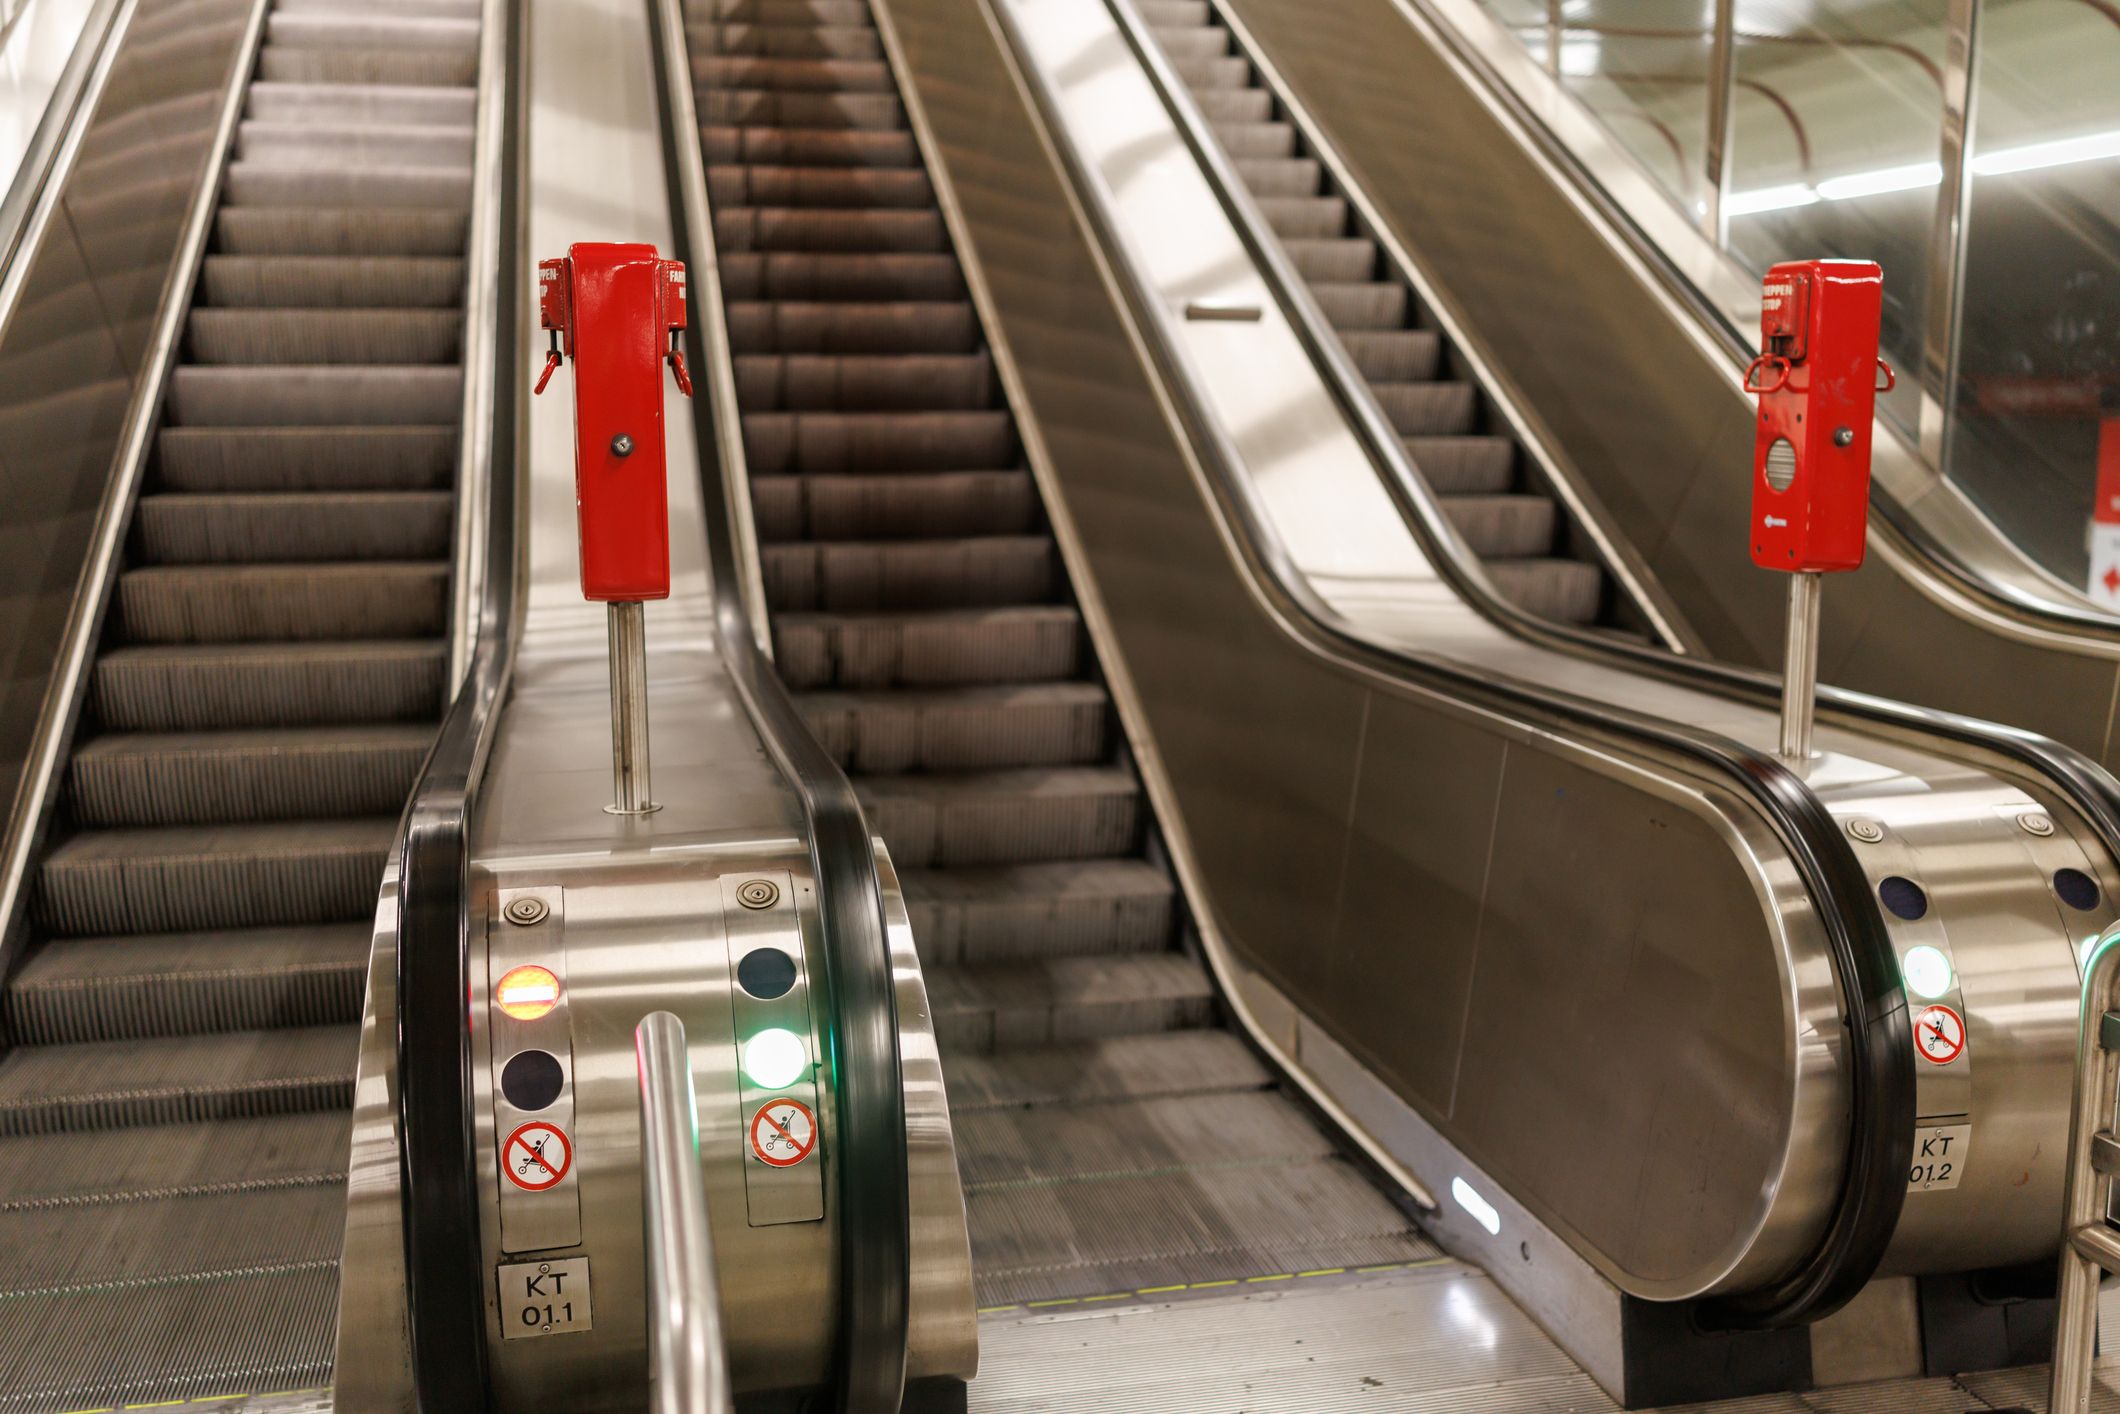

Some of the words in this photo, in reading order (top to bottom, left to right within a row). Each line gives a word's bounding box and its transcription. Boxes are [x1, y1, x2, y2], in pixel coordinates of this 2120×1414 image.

[1921, 1136, 1954, 1158] KT
[1909, 1163, 1953, 1183] 01.2
[526, 1272, 568, 1298] KT
[521, 1302, 572, 1326] 01.1
